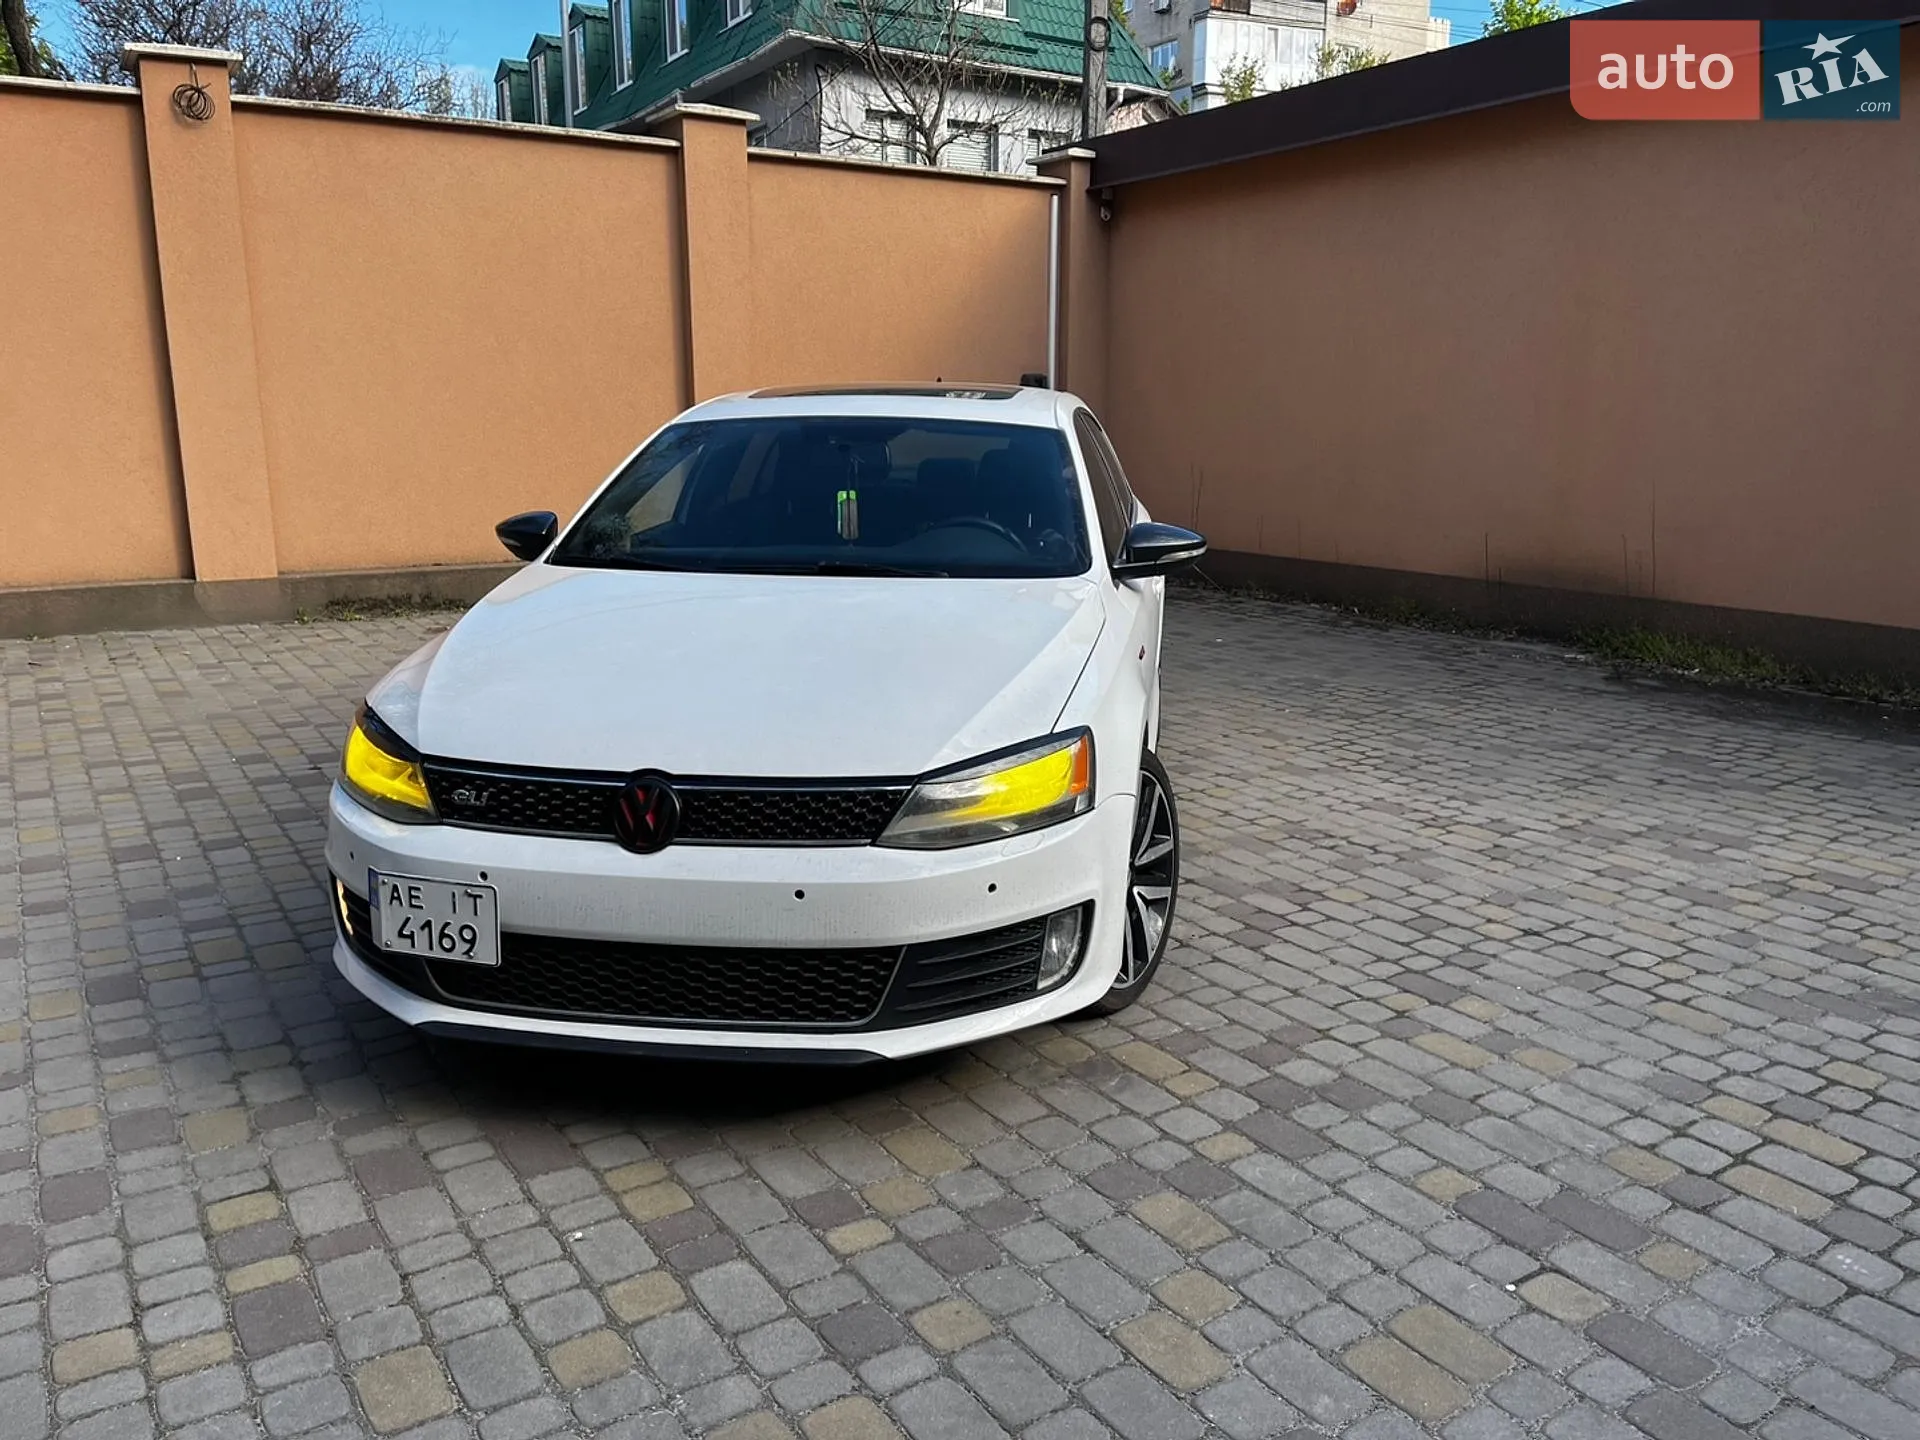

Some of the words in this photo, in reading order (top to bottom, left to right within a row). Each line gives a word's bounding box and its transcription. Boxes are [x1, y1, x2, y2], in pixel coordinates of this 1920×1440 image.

[389, 882, 425, 910] AE
[452, 890, 485, 917] IT
[397, 914, 480, 956] 4169
